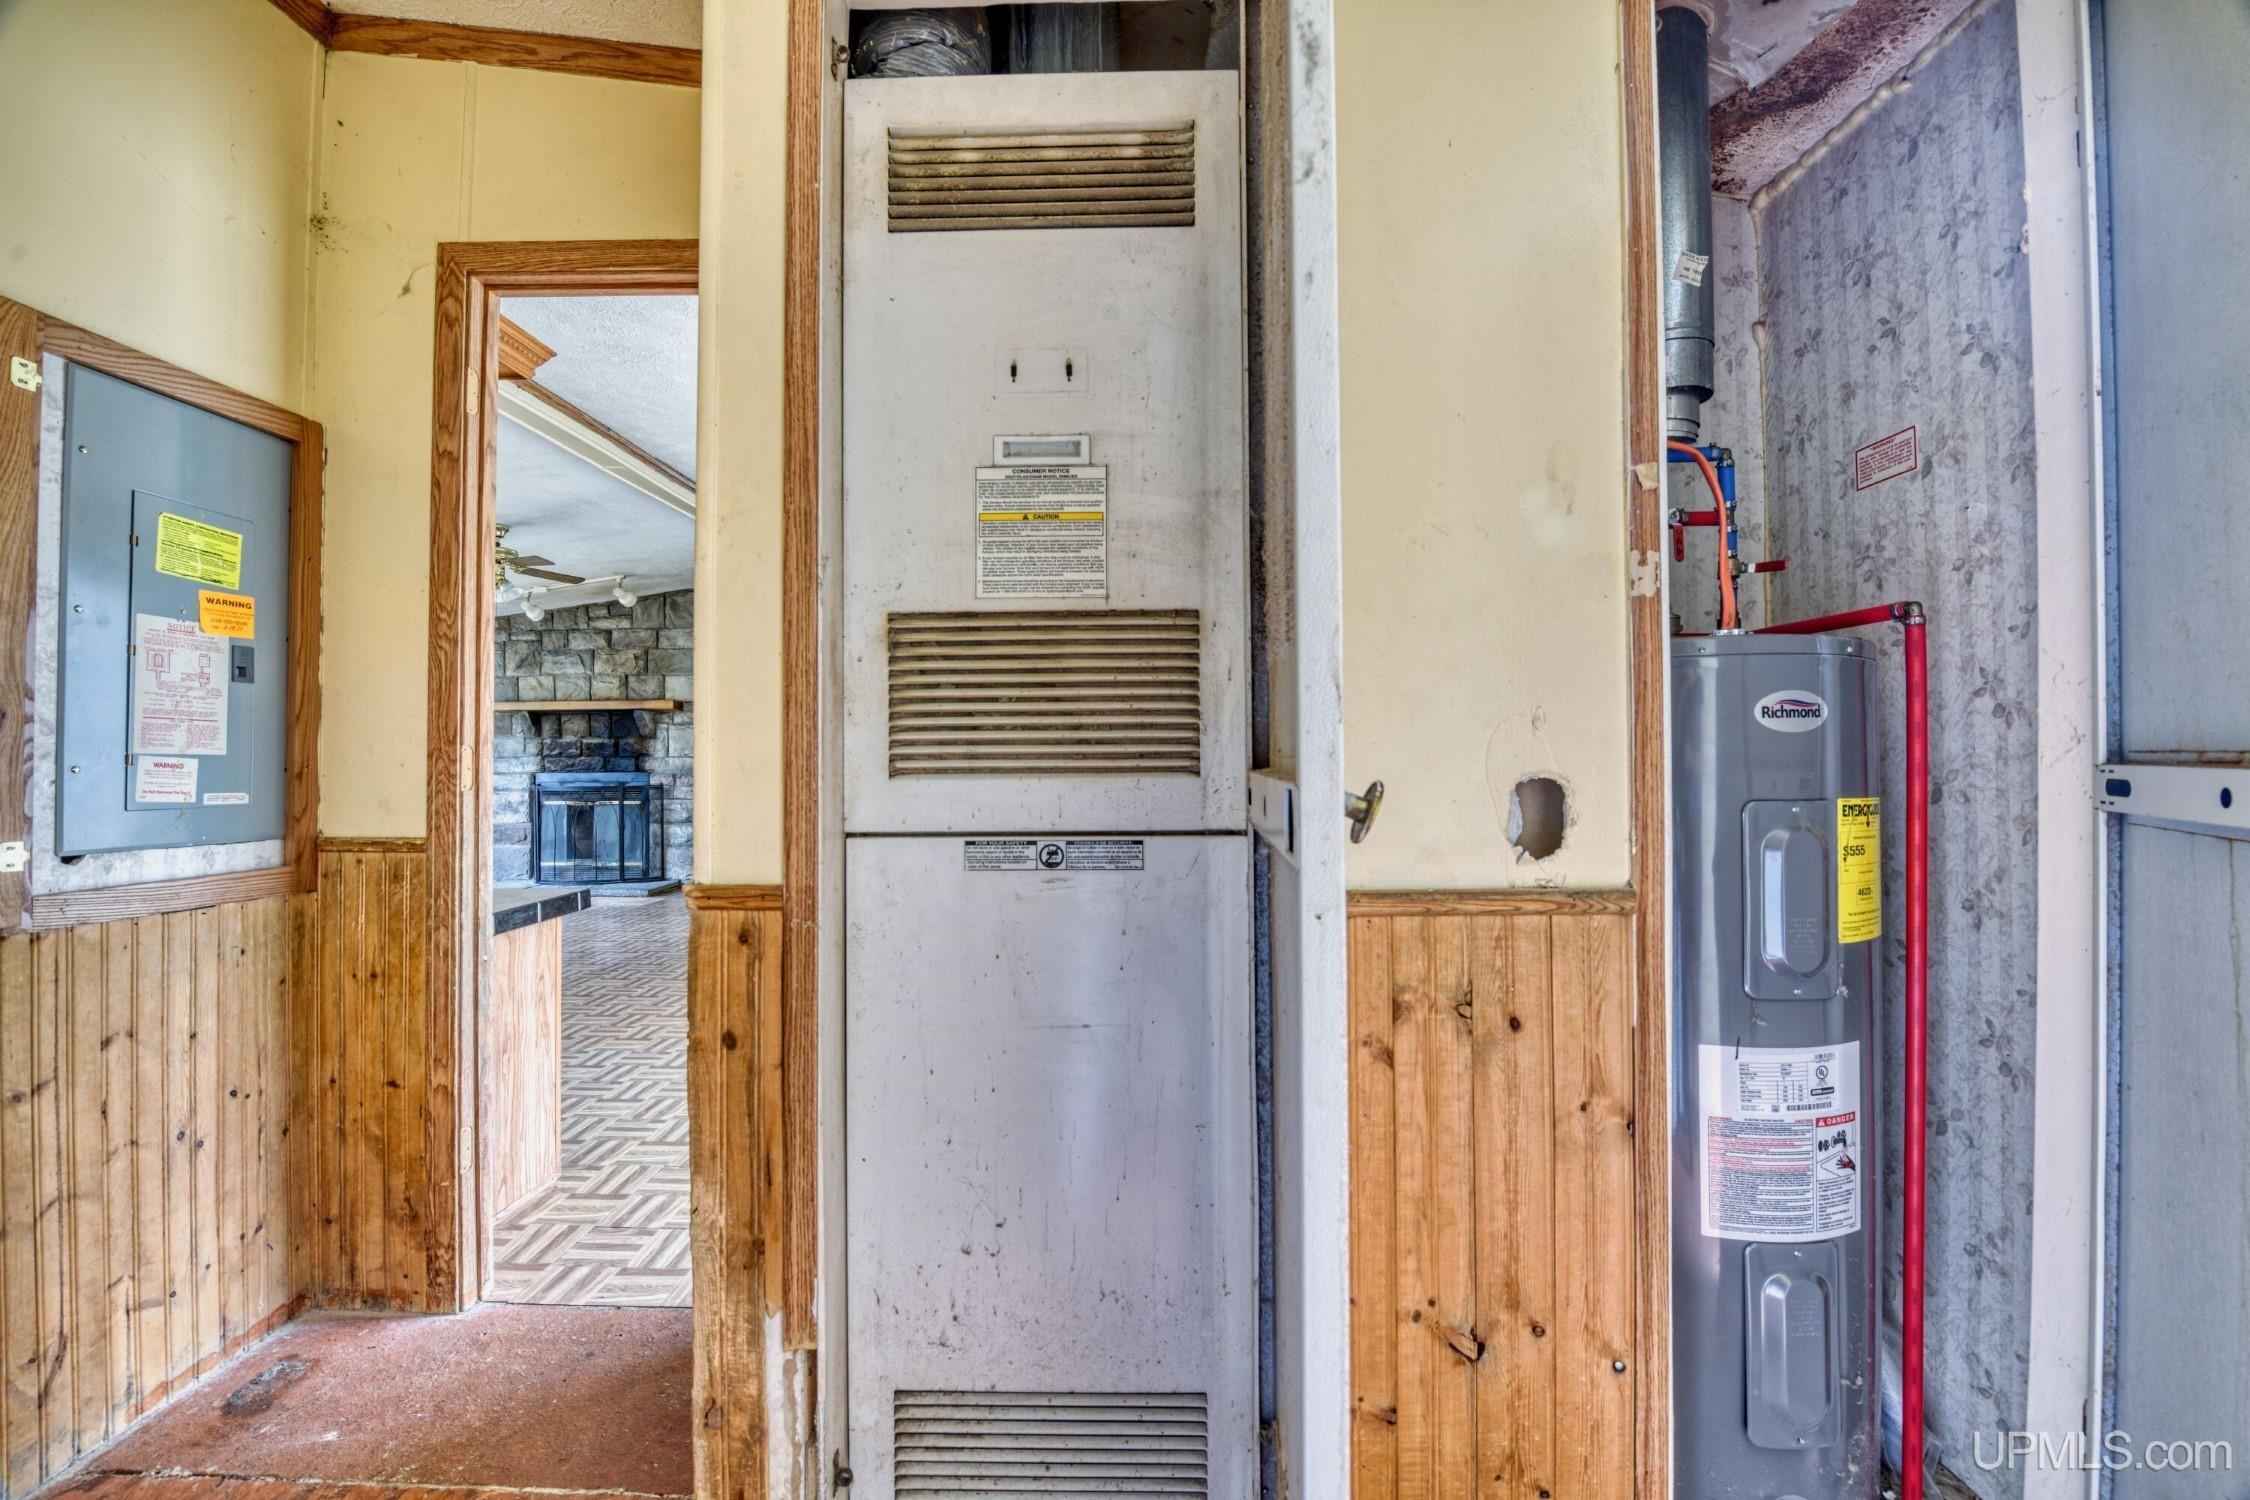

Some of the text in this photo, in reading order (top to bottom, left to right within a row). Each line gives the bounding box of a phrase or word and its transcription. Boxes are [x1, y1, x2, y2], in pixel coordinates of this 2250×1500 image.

[205, 597, 252, 610] WARNING
[167, 622, 195, 633] NOTICE
[1761, 704, 1821, 719] Richmond
[153, 761, 184, 770] WARNING
[1843, 845, 1866, 857] $555
[1826, 1112, 1854, 1125] DANGER
